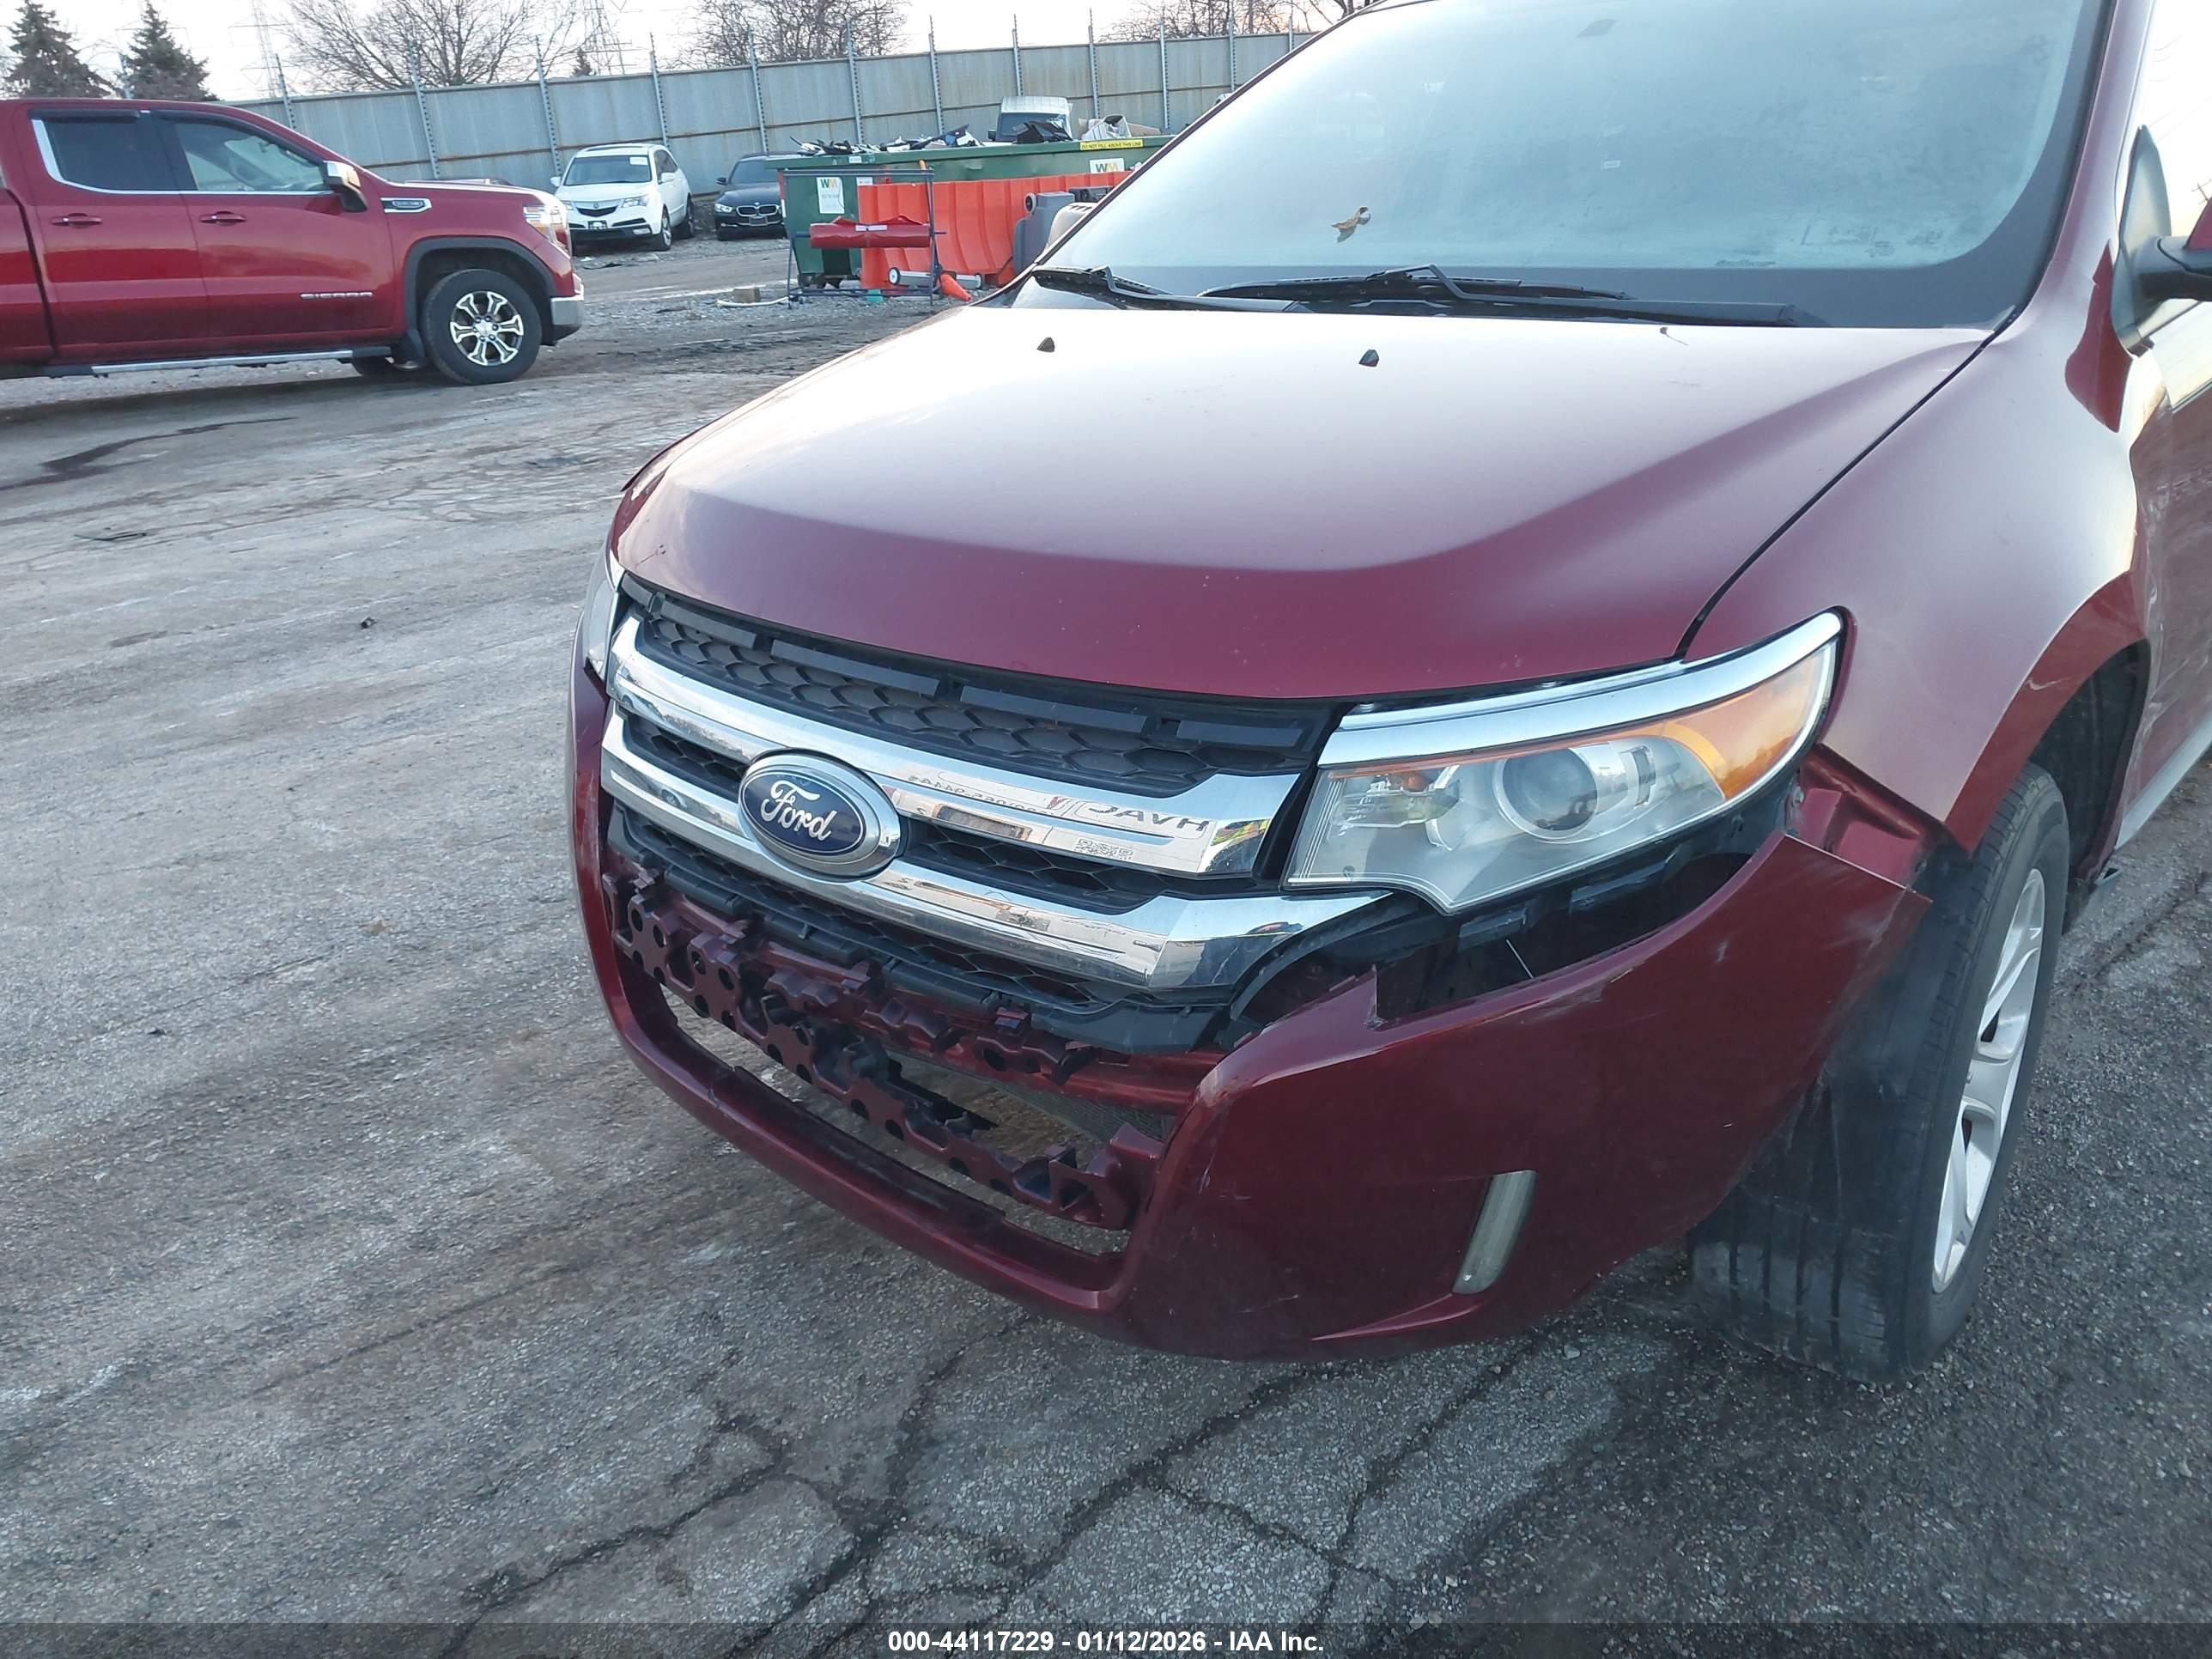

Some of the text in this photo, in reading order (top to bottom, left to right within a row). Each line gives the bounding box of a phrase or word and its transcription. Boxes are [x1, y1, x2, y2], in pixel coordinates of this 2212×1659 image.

[1096, 163, 1118, 172] WM
[821, 179, 837, 188] WM
[760, 780, 838, 842] Ford
